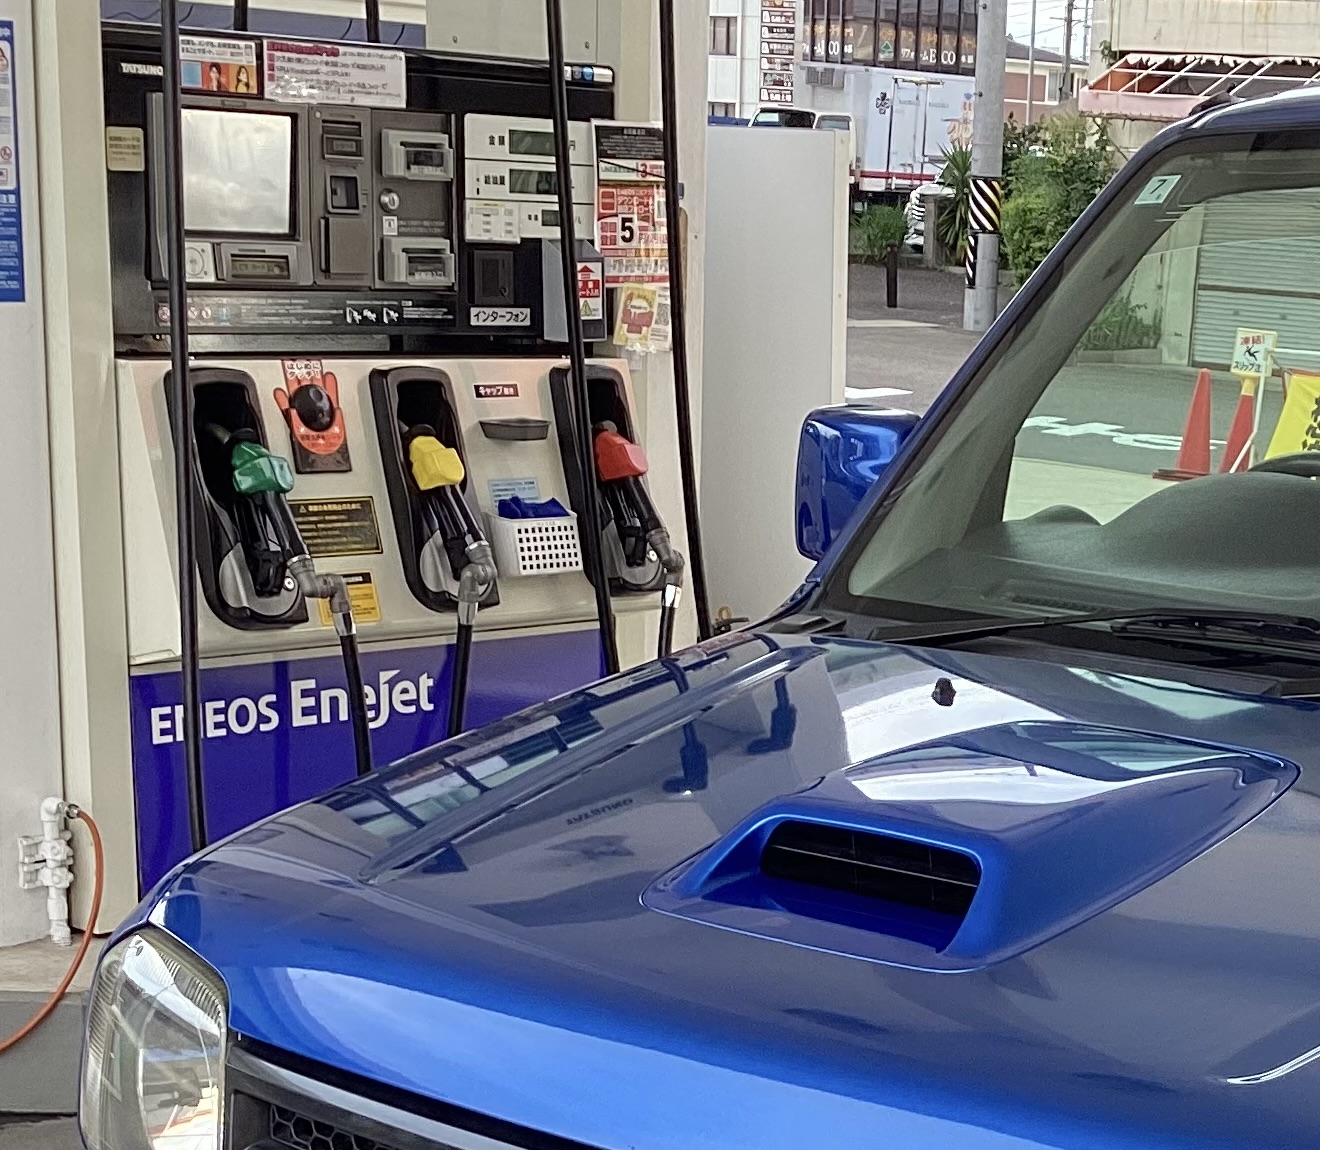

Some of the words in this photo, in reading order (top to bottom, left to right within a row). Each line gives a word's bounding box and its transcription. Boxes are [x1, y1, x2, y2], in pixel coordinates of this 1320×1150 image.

[1149, 178, 1169, 195] 7
[620, 216, 635, 243] 5
[473, 310, 528, 323] インターフォン
